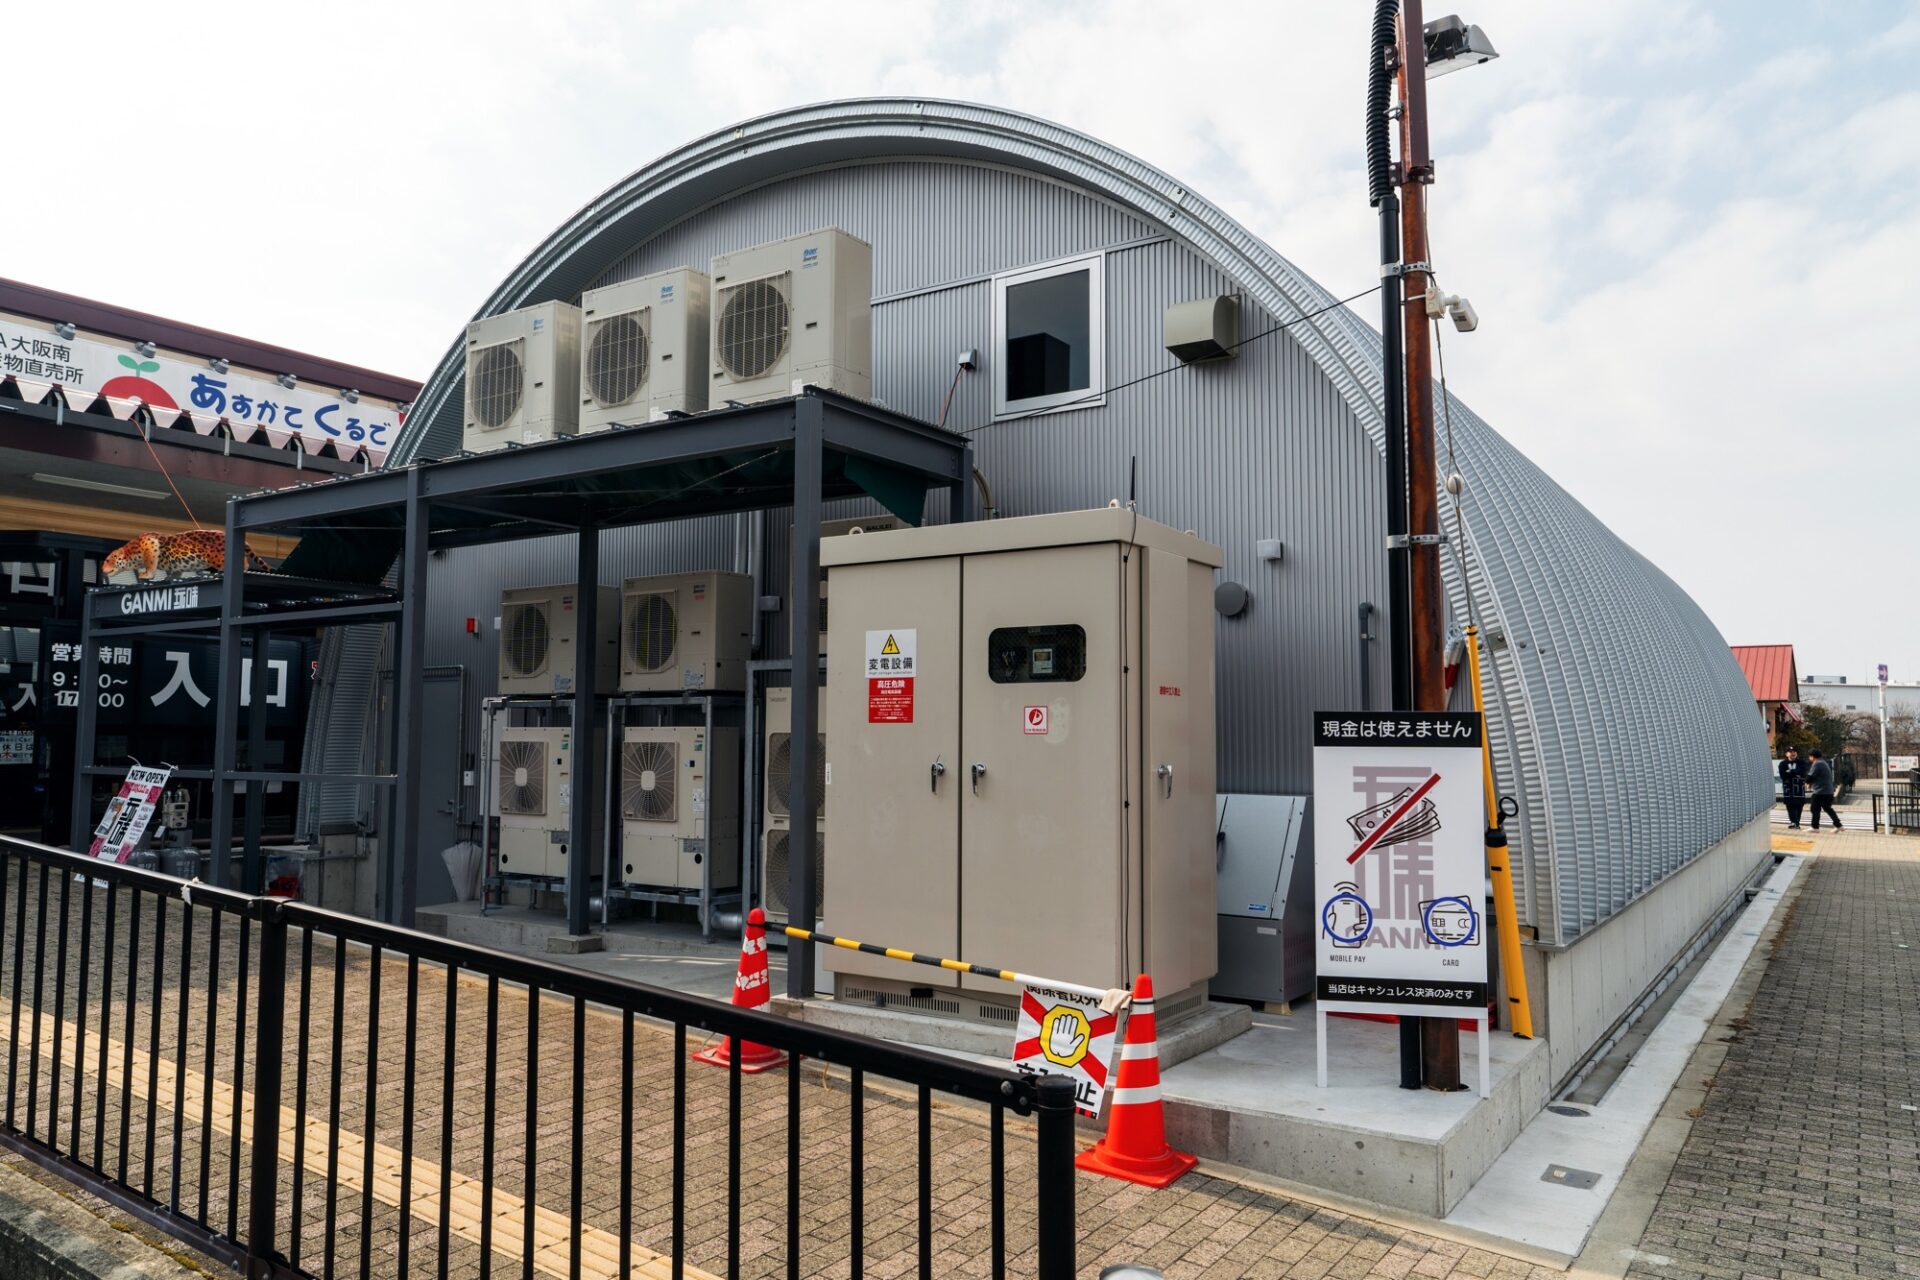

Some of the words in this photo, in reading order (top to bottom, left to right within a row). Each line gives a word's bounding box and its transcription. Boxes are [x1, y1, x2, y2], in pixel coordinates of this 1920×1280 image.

[0, 353, 84, 384] 物直売所
[190, 373, 391, 445] あすかてくるで
[121, 588, 172, 614] GANMI
[868, 656, 913, 671] 変電設備
[1322, 720, 1472, 738] 現金は使えません
[128, 769, 146, 781] NEW
[145, 772, 167, 784] OPEN
[1329, 954, 1352, 963] MOBILE
[1354, 955, 1366, 963] PAY
[1442, 959, 1460, 967] CARD
[1328, 983, 1475, 1000] 当店はキャシュレス決済のみです
